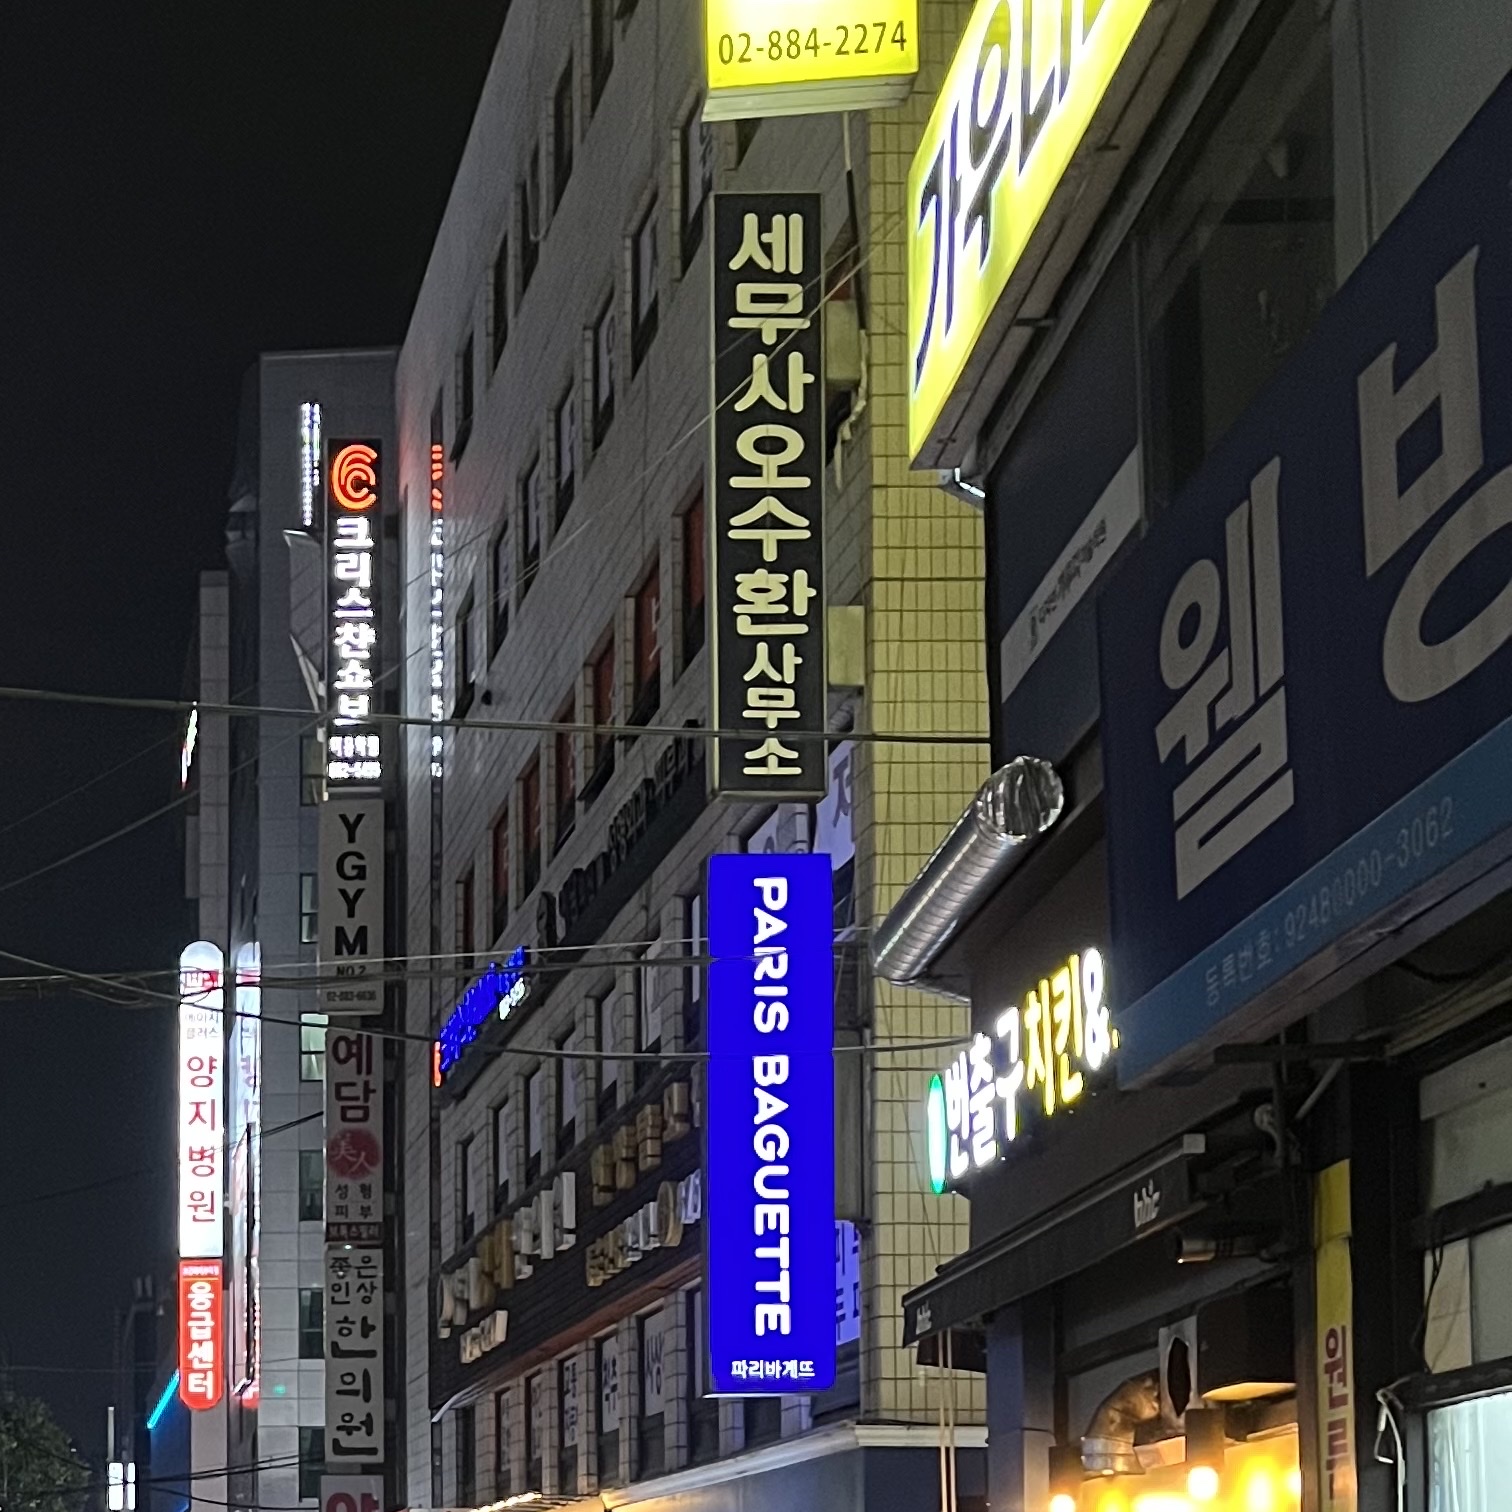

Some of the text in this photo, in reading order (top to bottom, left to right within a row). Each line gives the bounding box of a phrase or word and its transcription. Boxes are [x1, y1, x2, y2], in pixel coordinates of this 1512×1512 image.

[718, 20, 907, 65] 02-884-2274
[334, 812, 369, 956] YGYM
[331, 1033, 377, 1123] 예담
[753, 876, 792, 1338] PARIS BAGUETTE
[186, 1055, 217, 1223] 양지병원
[334, 1204, 373, 1219] 피부
[329, 1255, 378, 1280] 좋은
[330, 1280, 378, 1305] 인상
[186, 1281, 216, 1400] 응급센터
[330, 1315, 379, 1456] 한의원
[730, 1359, 816, 1379] 파리바게뜨
